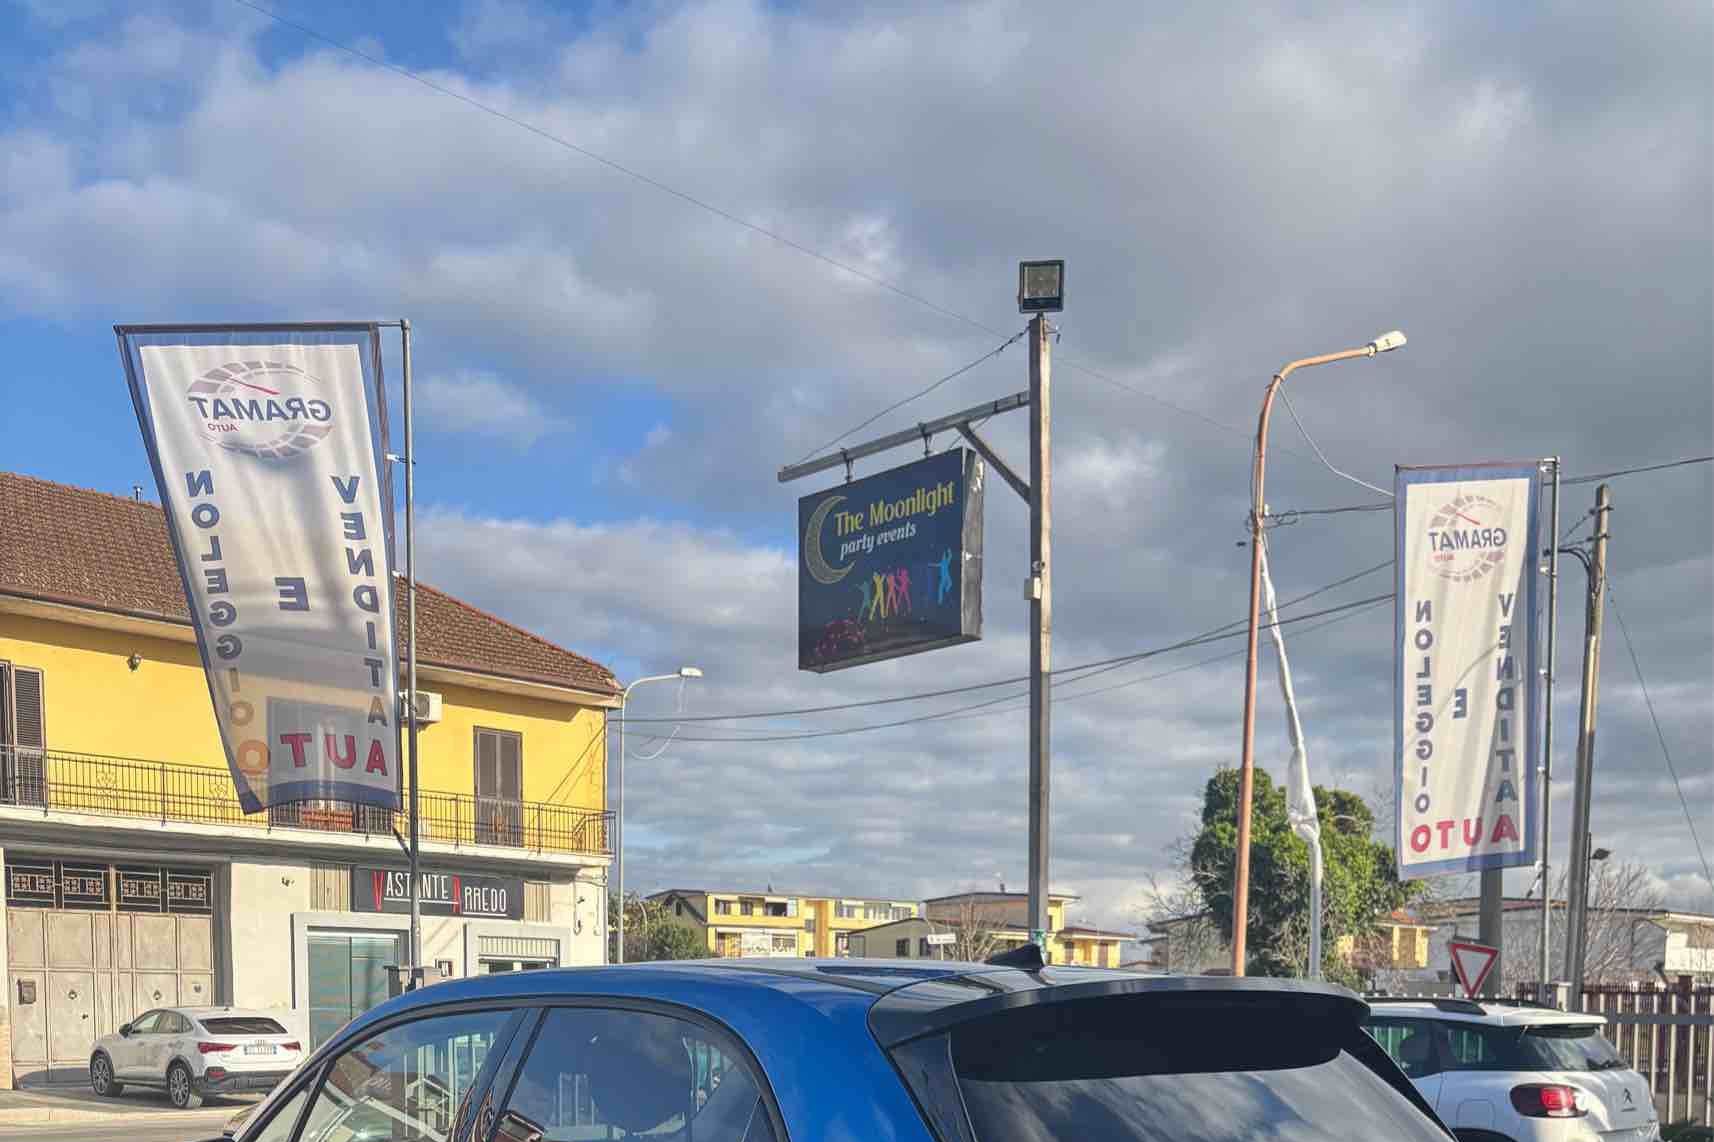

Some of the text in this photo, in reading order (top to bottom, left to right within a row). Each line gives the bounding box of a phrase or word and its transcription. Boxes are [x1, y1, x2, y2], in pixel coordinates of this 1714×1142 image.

[834, 481, 955, 536] The Moonlight
[840, 520, 917, 561] party events
[371, 868, 449, 912] VASTNTE
